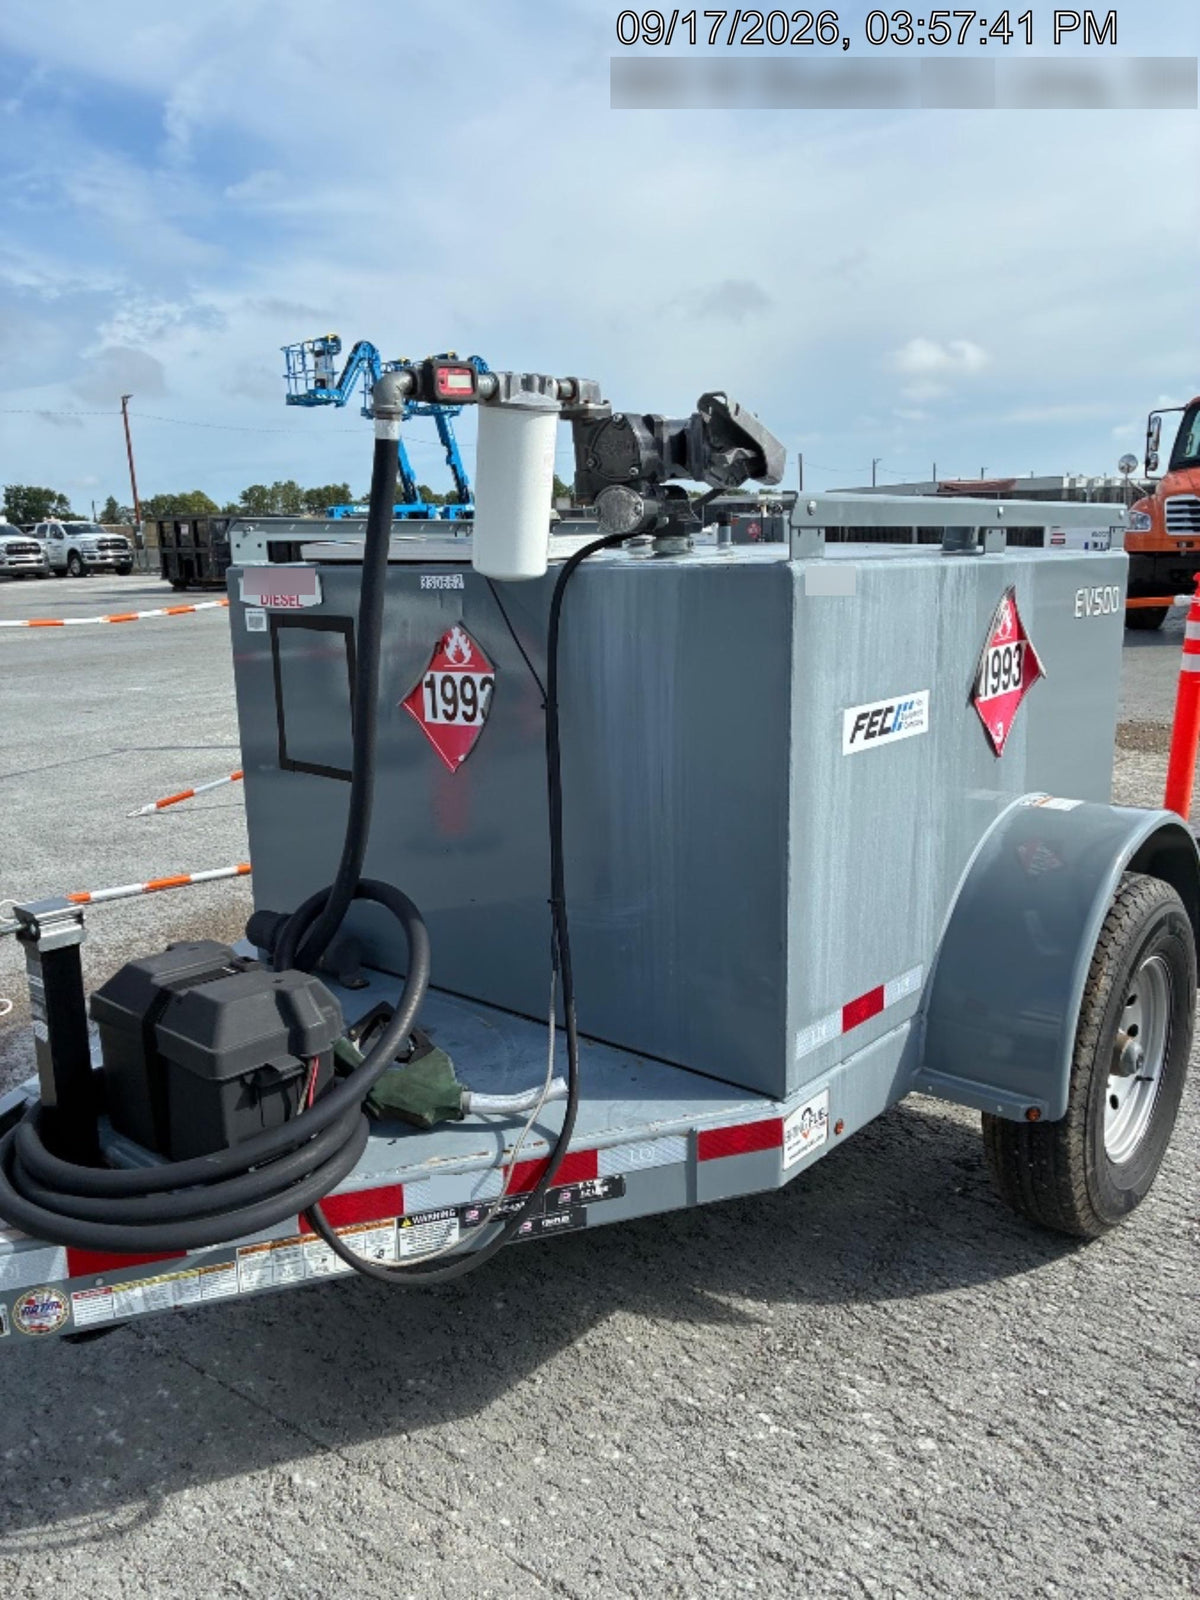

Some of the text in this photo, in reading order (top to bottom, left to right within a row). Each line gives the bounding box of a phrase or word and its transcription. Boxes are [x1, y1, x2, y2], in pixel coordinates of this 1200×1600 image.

[260, 594, 304, 608] DIESEL
[1075, 586, 1120, 618] EV500
[984, 643, 1023, 697] 1993
[849, 706, 894, 744] FEC
